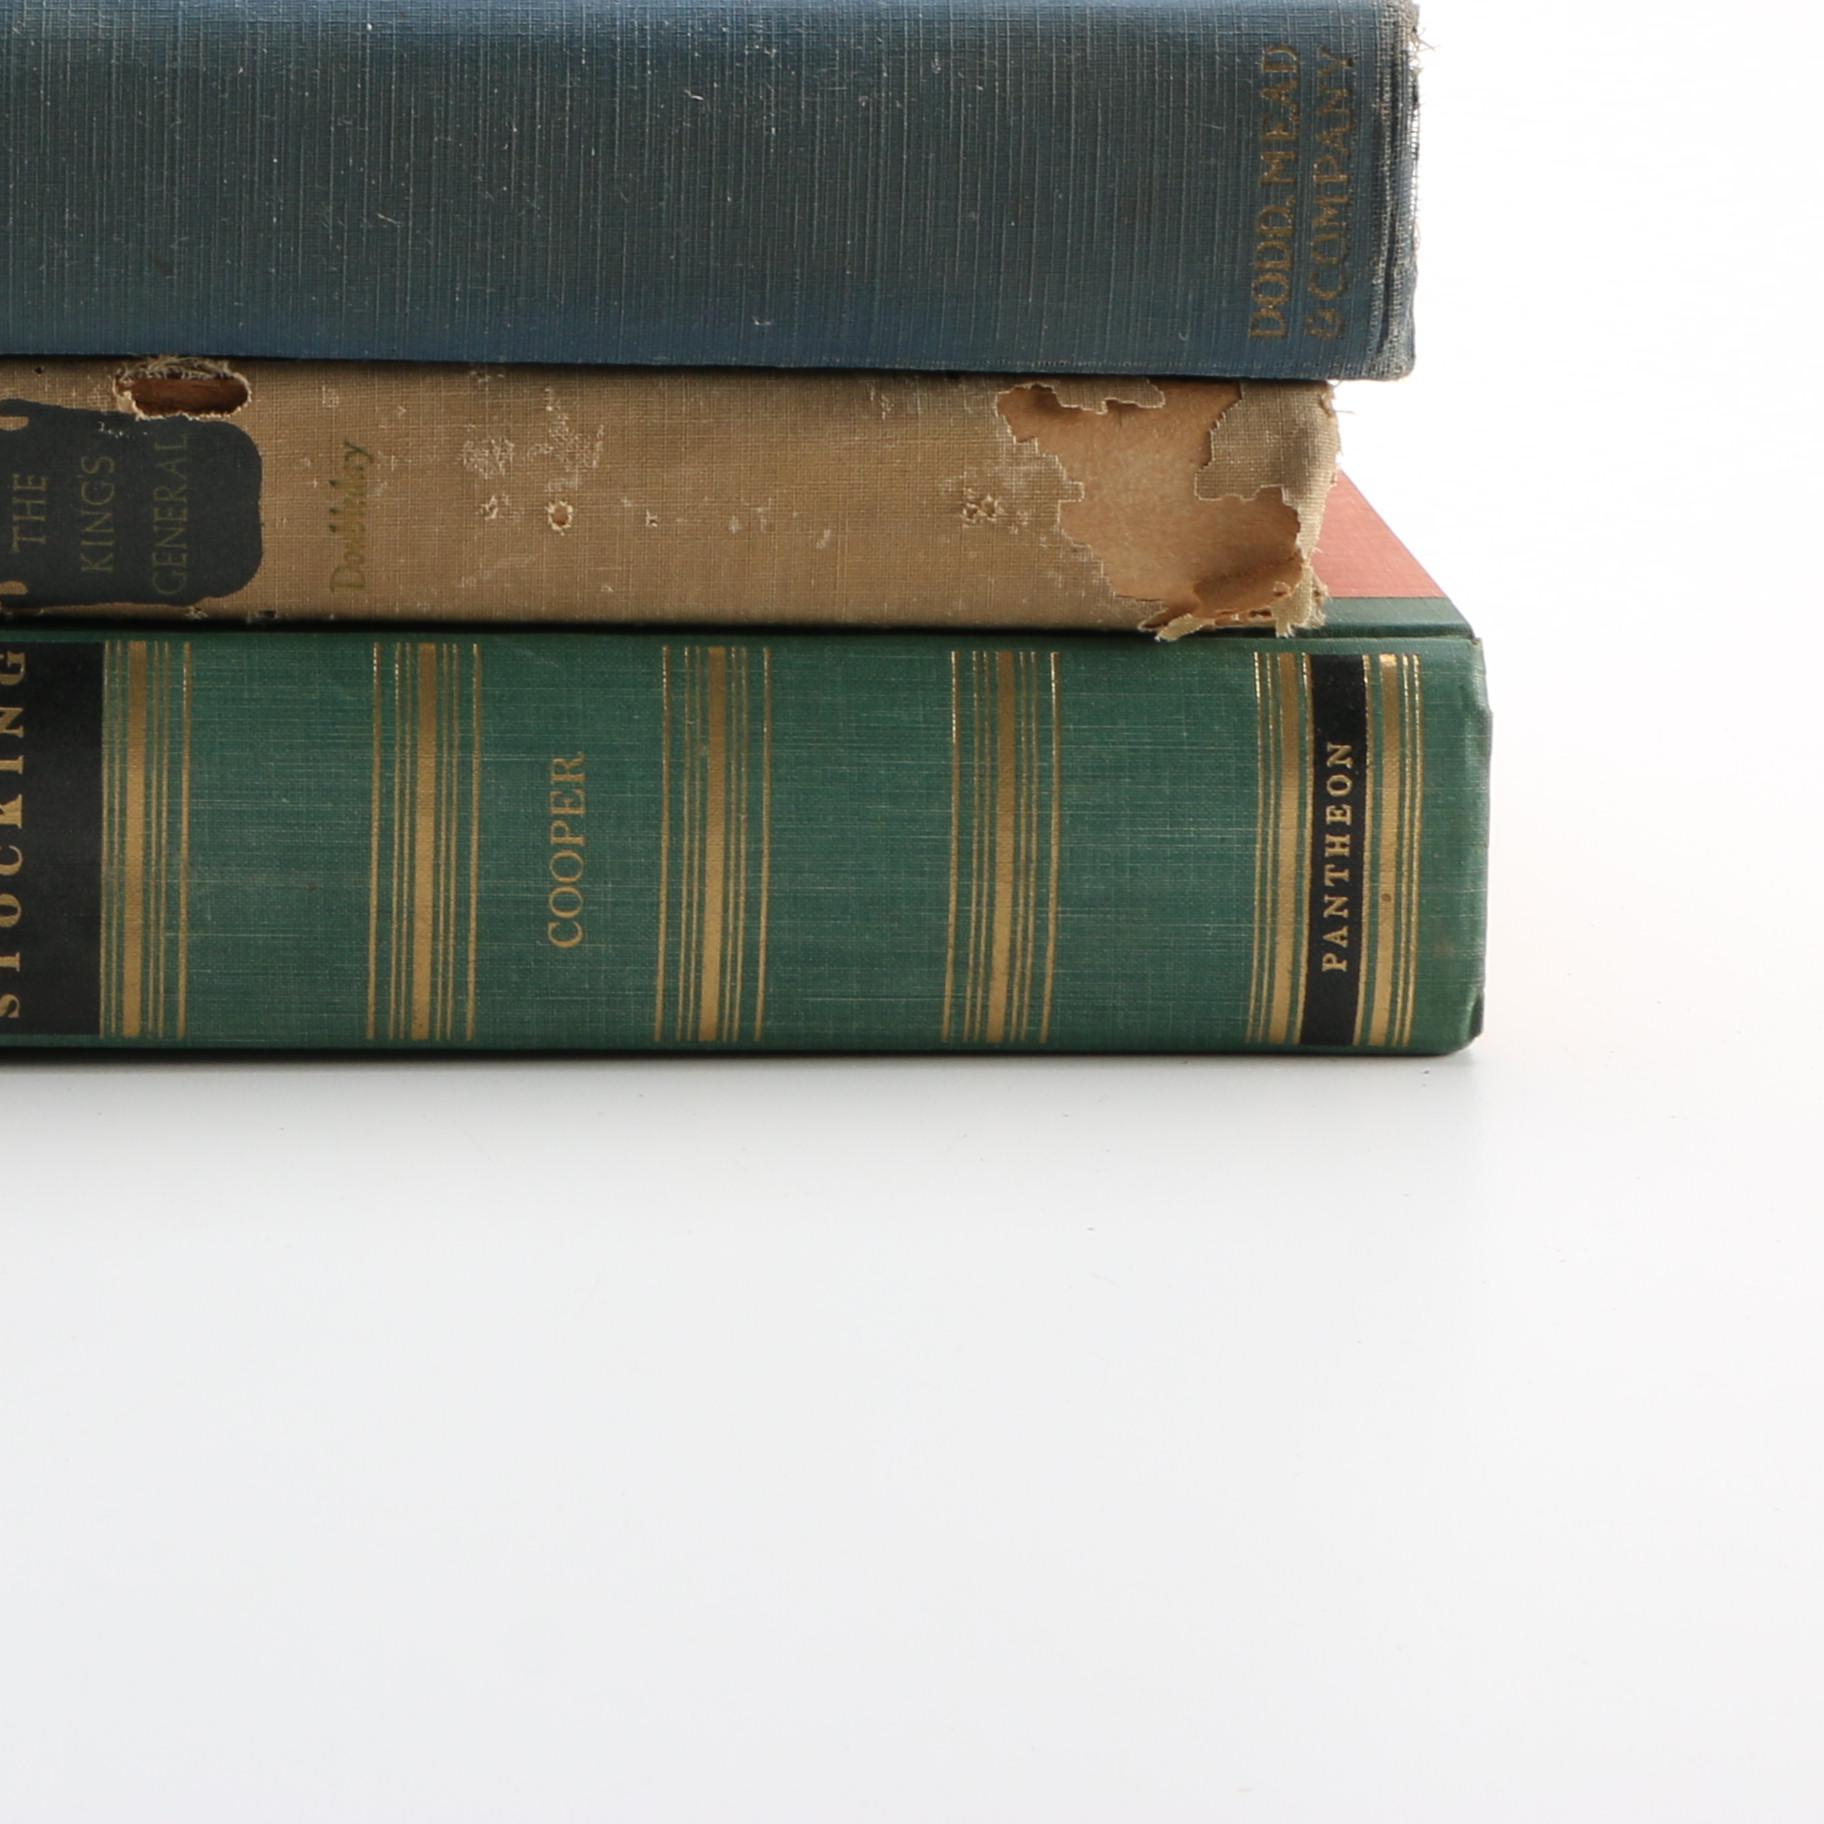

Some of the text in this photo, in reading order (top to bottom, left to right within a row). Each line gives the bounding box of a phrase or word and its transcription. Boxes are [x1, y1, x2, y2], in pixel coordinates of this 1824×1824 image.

[1259, 42, 1301, 188] MEAD
[10, 474, 49, 553] THE
[152, 433, 189, 595] GENERAL
[547, 750, 588, 950] COOPER
[1321, 740, 1354, 974] PANTHEON
